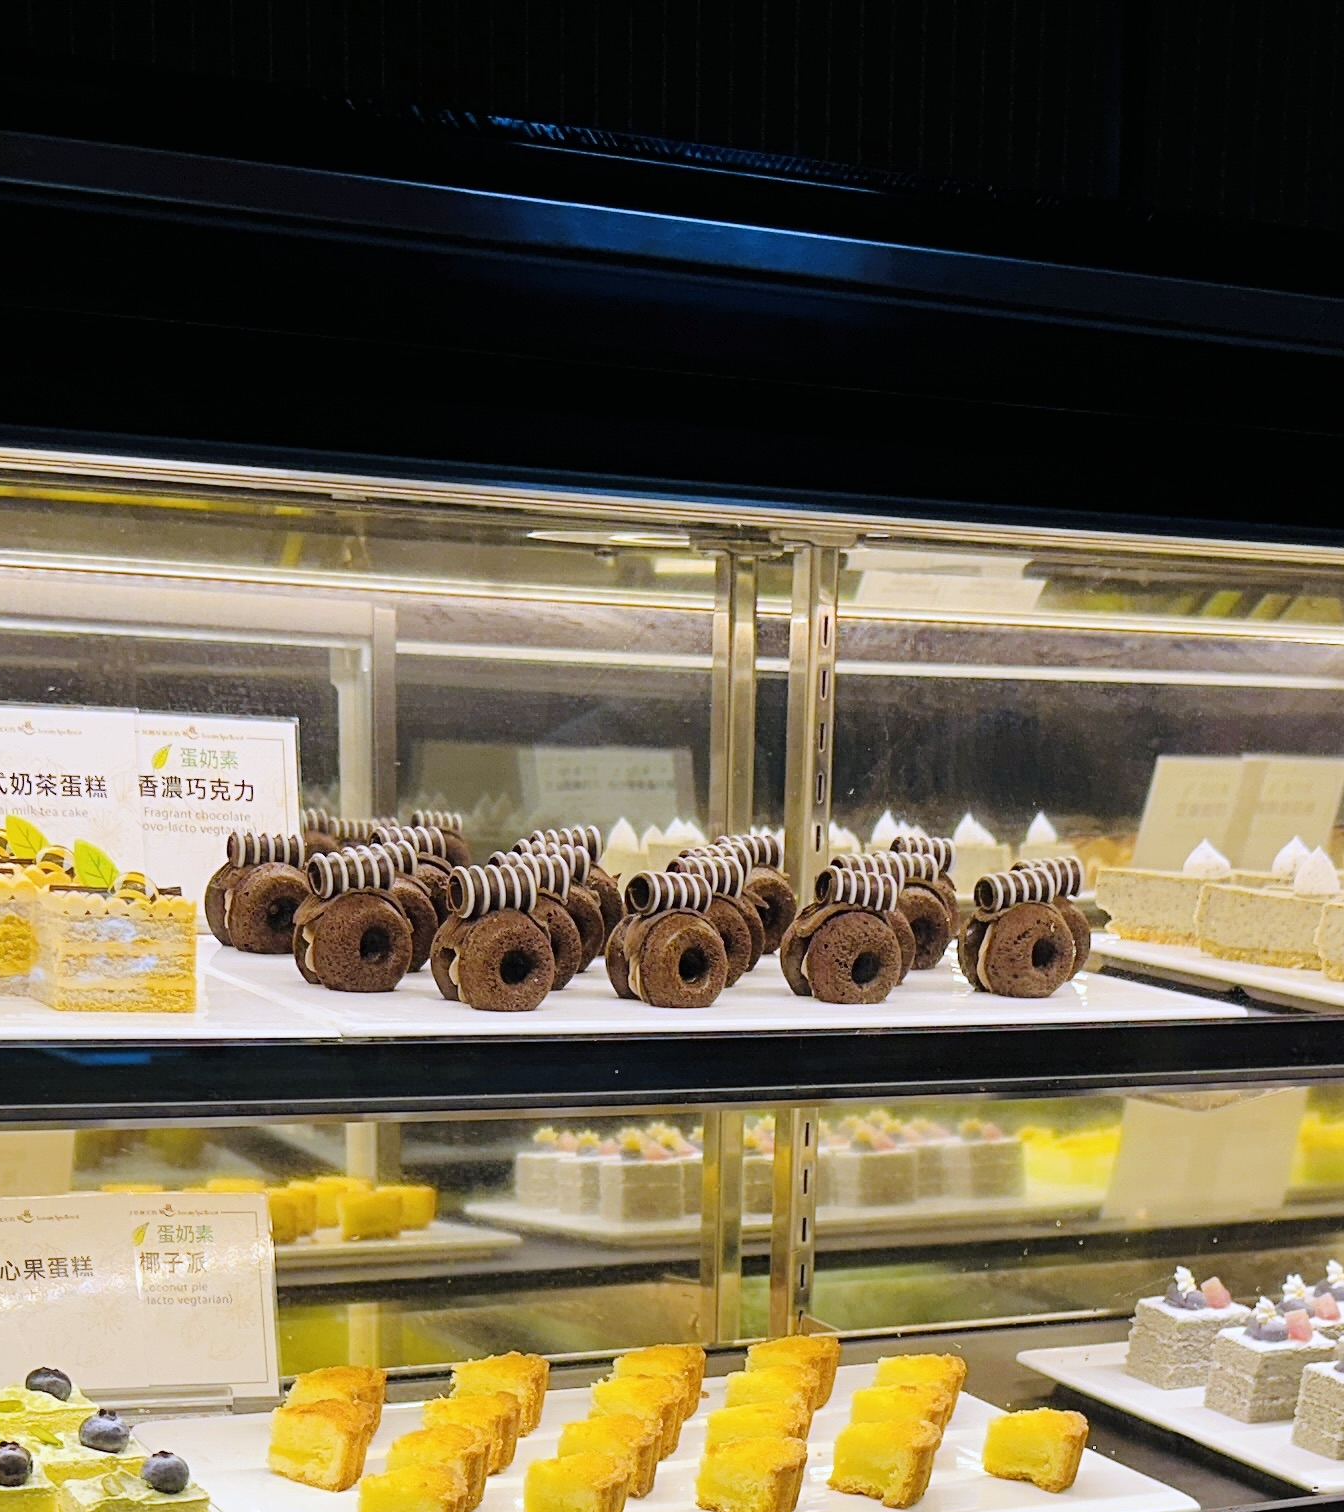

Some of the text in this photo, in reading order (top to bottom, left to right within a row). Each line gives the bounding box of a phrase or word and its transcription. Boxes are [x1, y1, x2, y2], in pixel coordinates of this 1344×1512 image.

[180, 746, 240, 771] 蛋奶素
[138, 773, 255, 803] 香濃巧克力
[11, 804, 37, 816] milk
[39, 807, 58, 817] tea
[61, 807, 89, 818] cake
[143, 806, 251, 822] Fragrant chocolate
[156, 1224, 214, 1244] 蛋奶素
[139, 1251, 208, 1275] 椰子派
[191, 1282, 208, 1294] pie
